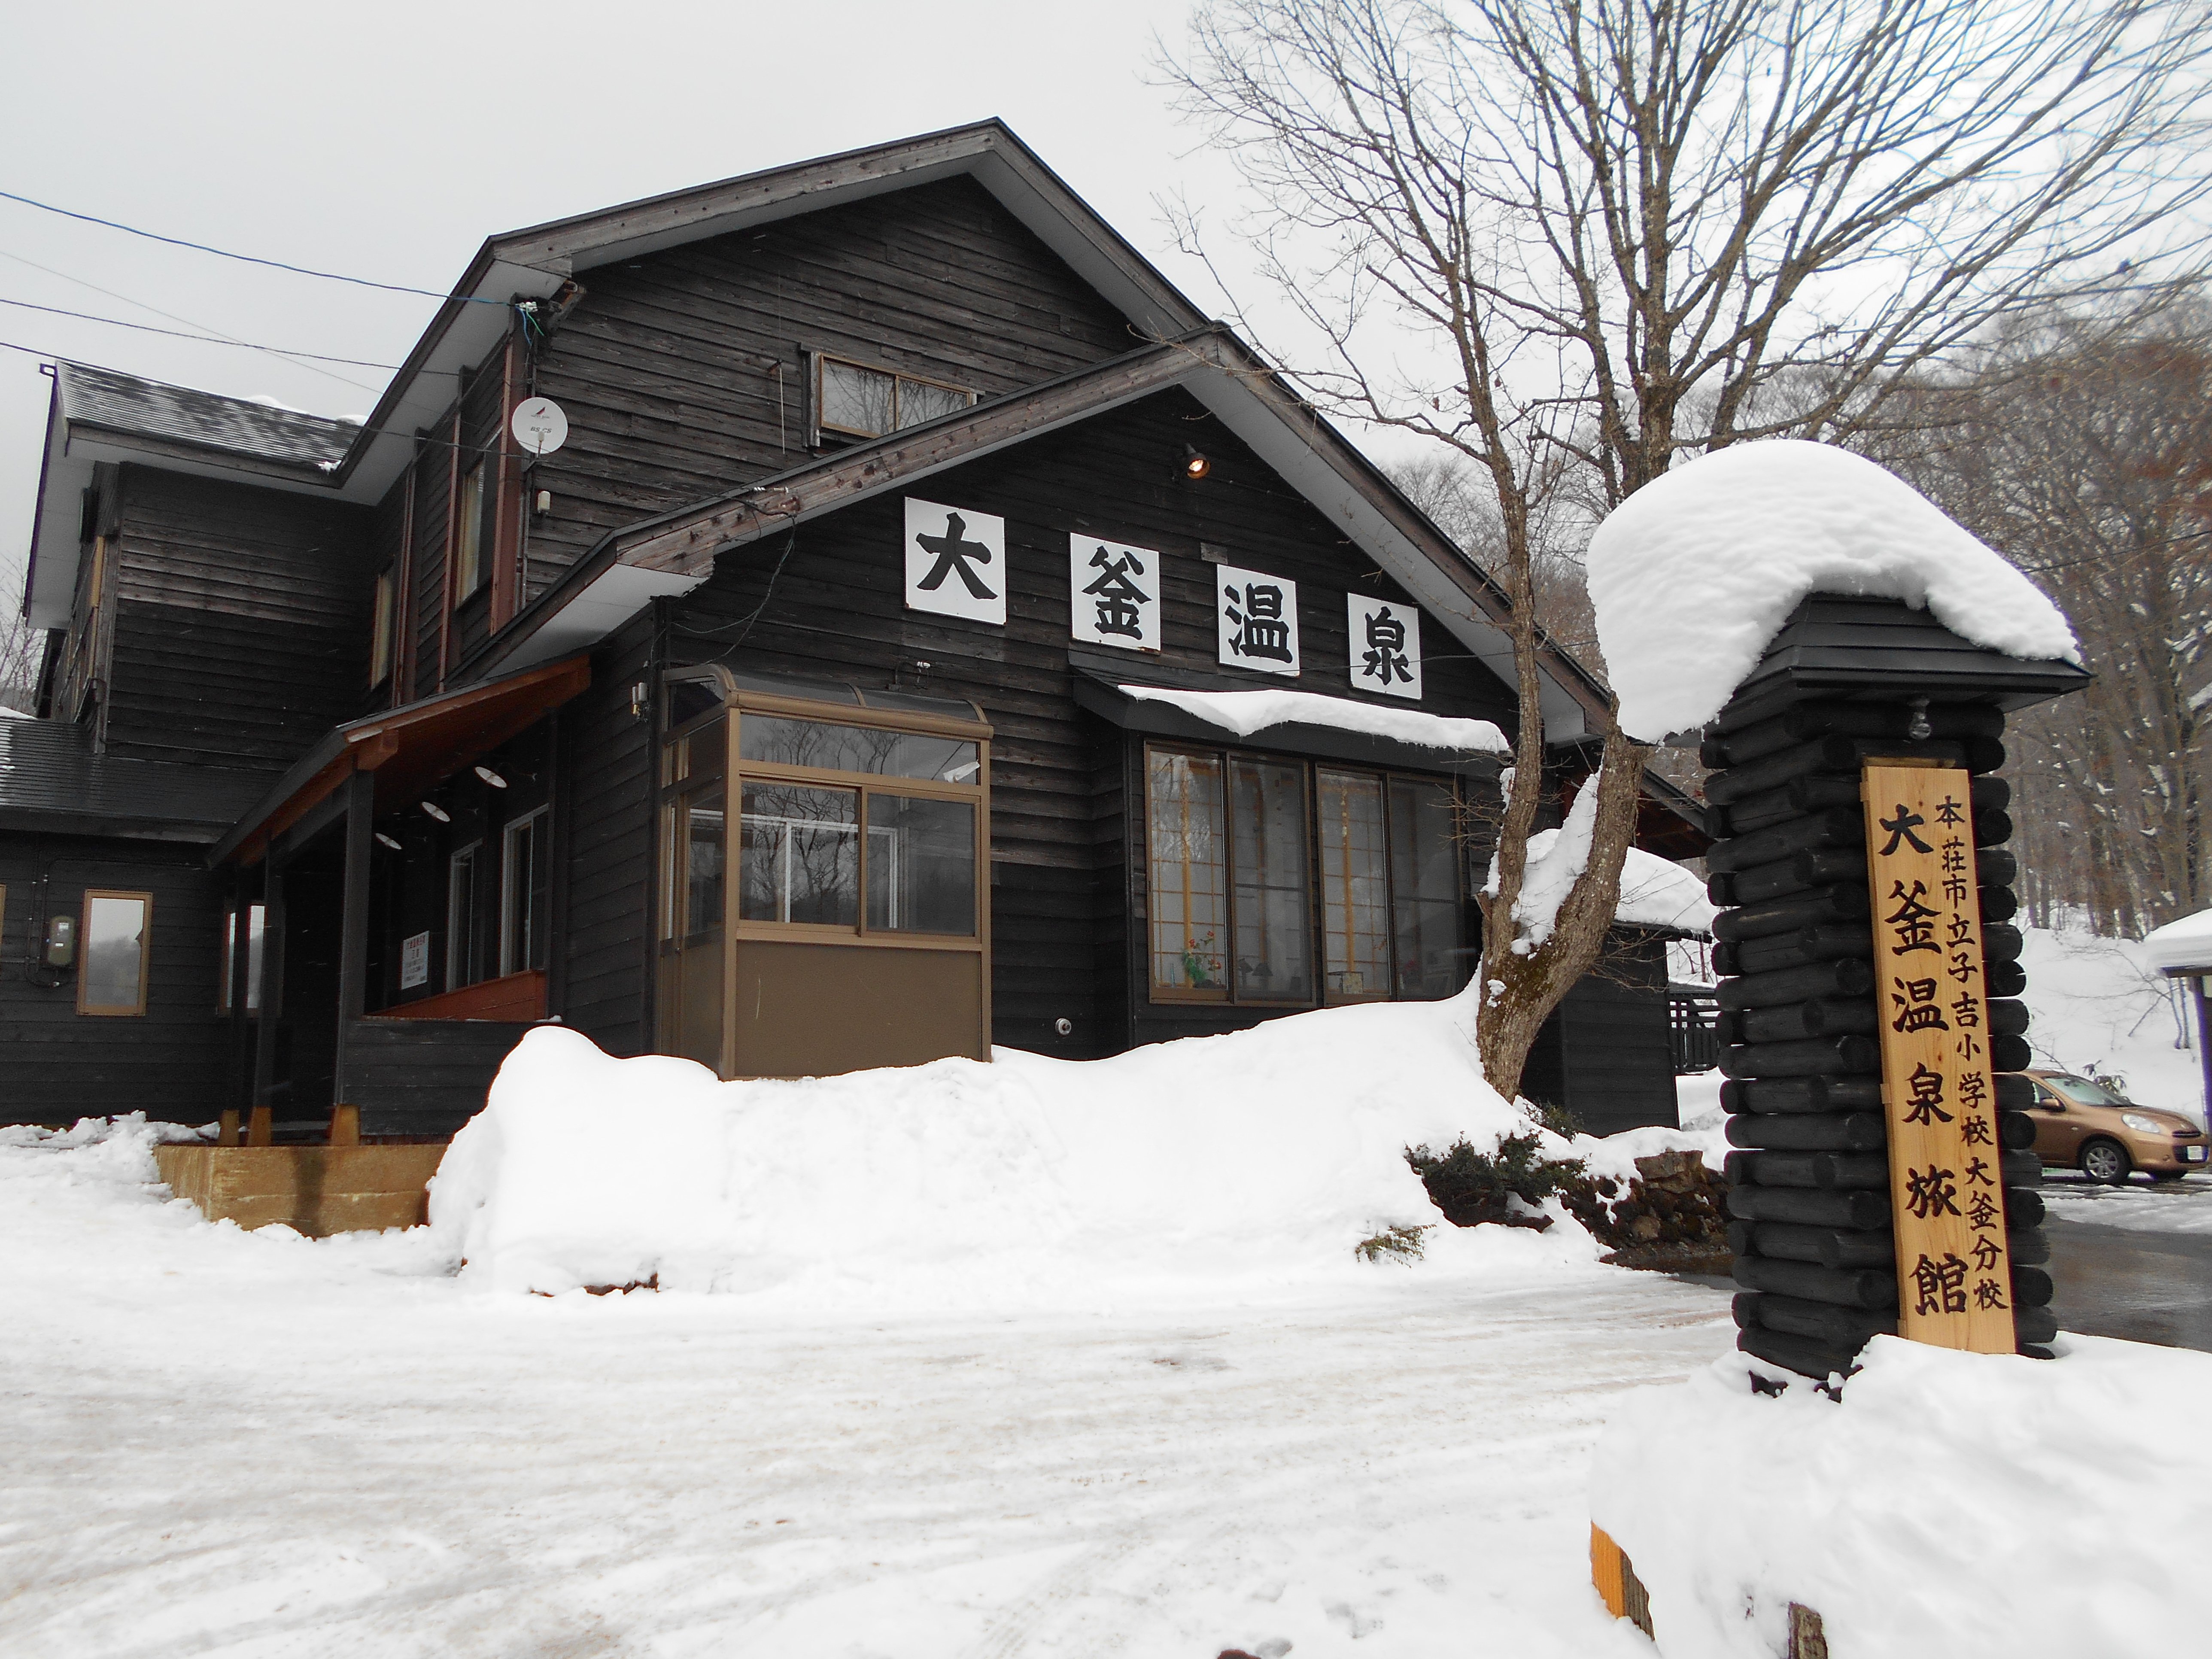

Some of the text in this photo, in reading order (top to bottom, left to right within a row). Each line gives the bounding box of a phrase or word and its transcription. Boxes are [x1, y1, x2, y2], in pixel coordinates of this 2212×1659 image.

[916, 512, 1414, 686] 大釜温泉
[1878, 804, 1968, 1316] 大釜温泉旅館
[1935, 795, 2008, 1310] 本荘市立子吉小学校大釜分校
